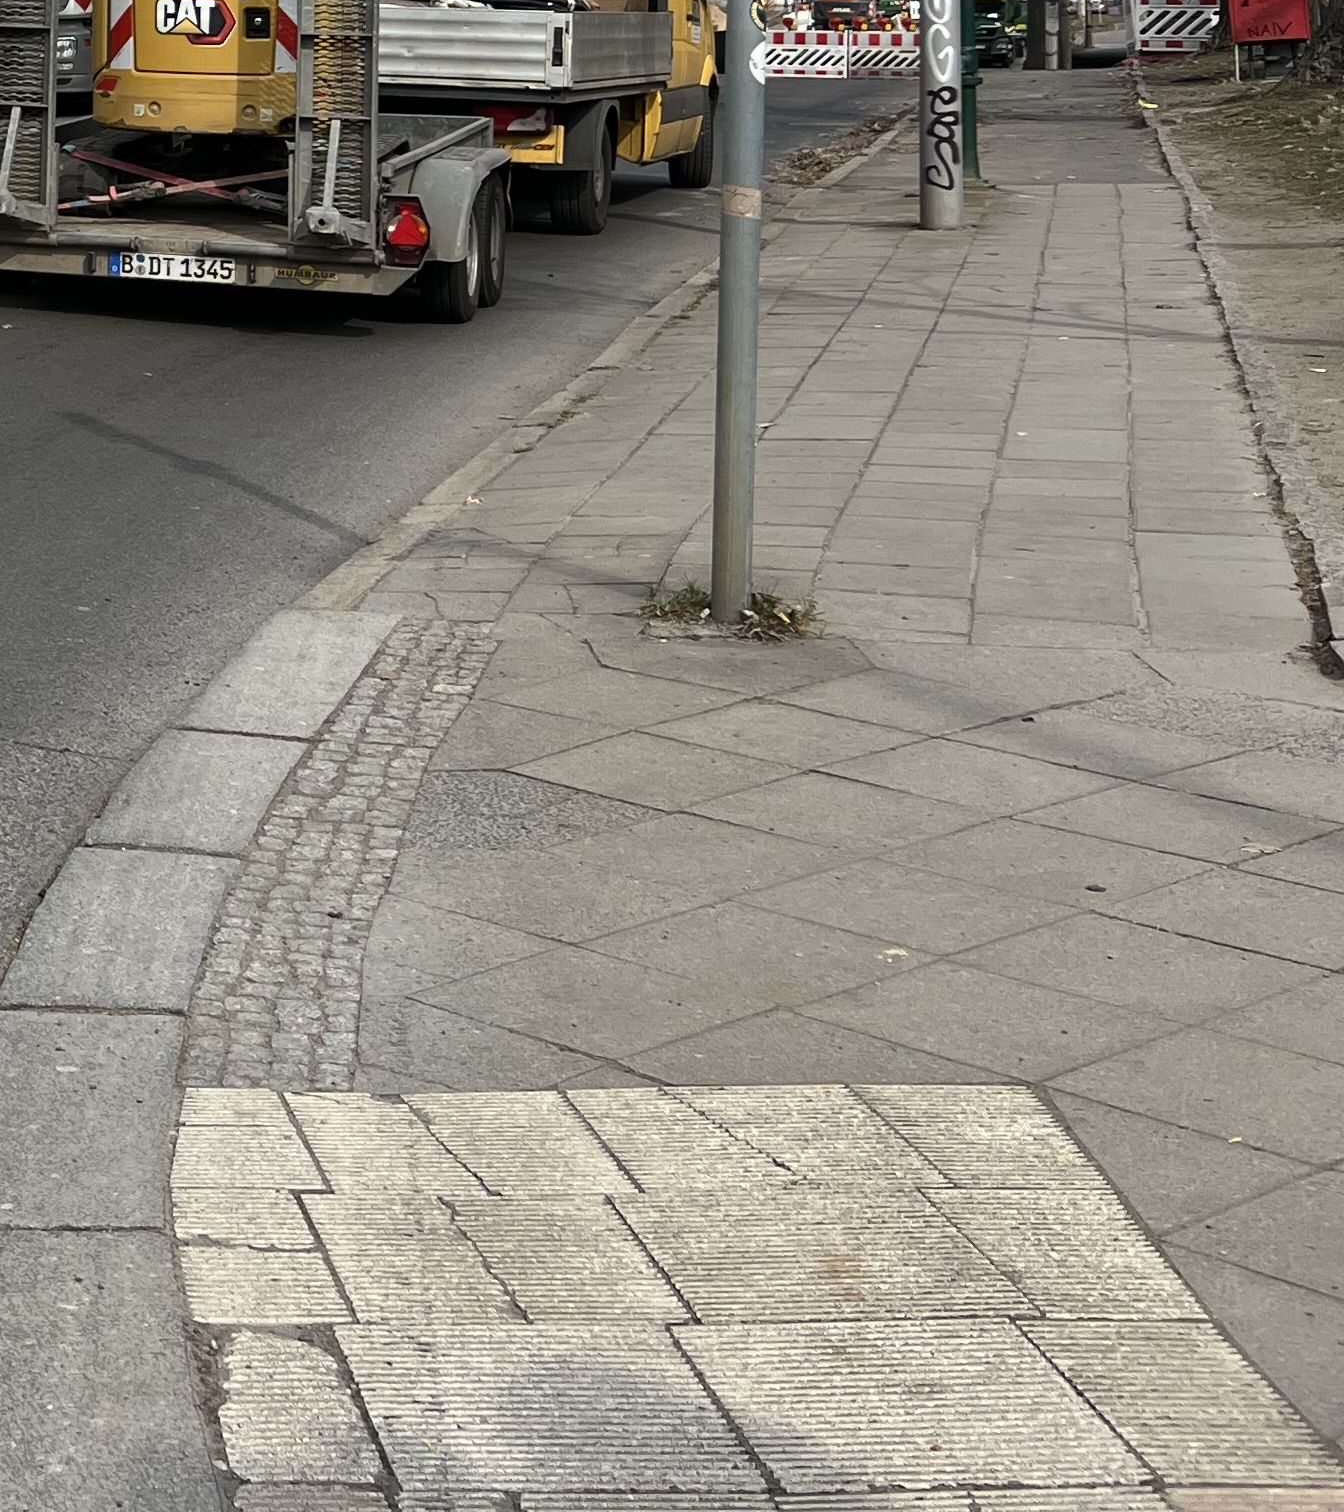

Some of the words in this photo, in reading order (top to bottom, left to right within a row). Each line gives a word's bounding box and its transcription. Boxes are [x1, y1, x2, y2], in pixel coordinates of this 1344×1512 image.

[121, 254, 134, 274] B
[148, 256, 175, 277] DT
[180, 258, 233, 280] 1345
